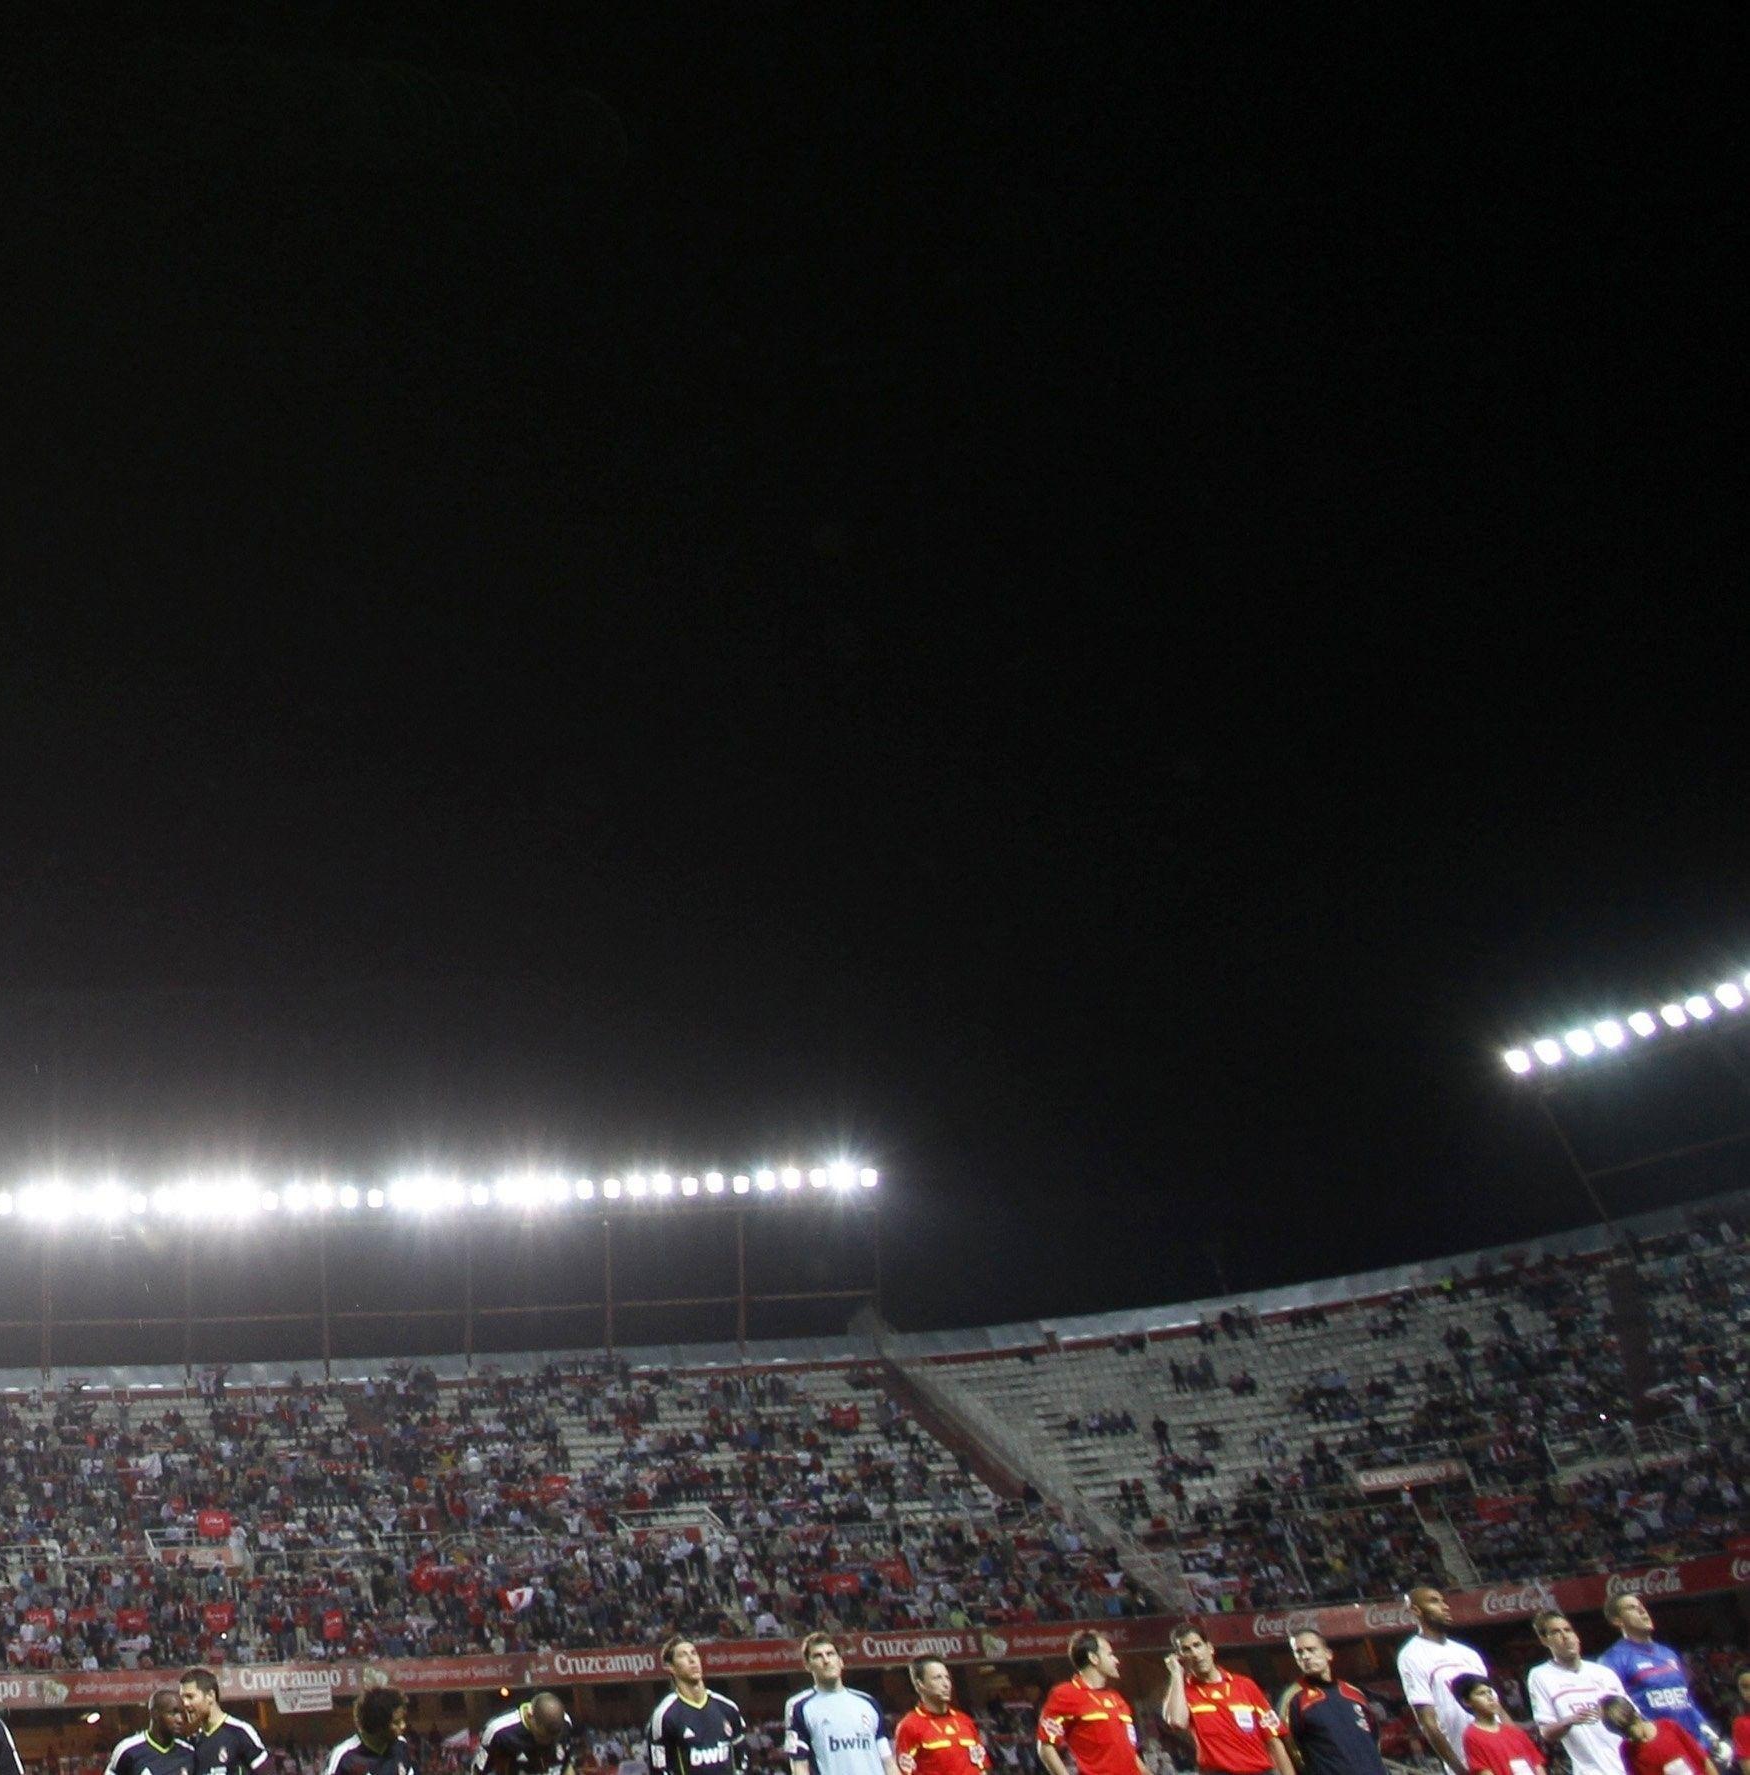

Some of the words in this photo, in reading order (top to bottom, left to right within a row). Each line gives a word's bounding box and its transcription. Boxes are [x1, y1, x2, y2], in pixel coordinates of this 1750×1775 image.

[862, 1635, 962, 1658] Cruzcampo
[554, 1652, 654, 1676] Cruzcampo
[829, 1733, 871, 1752] bwin
